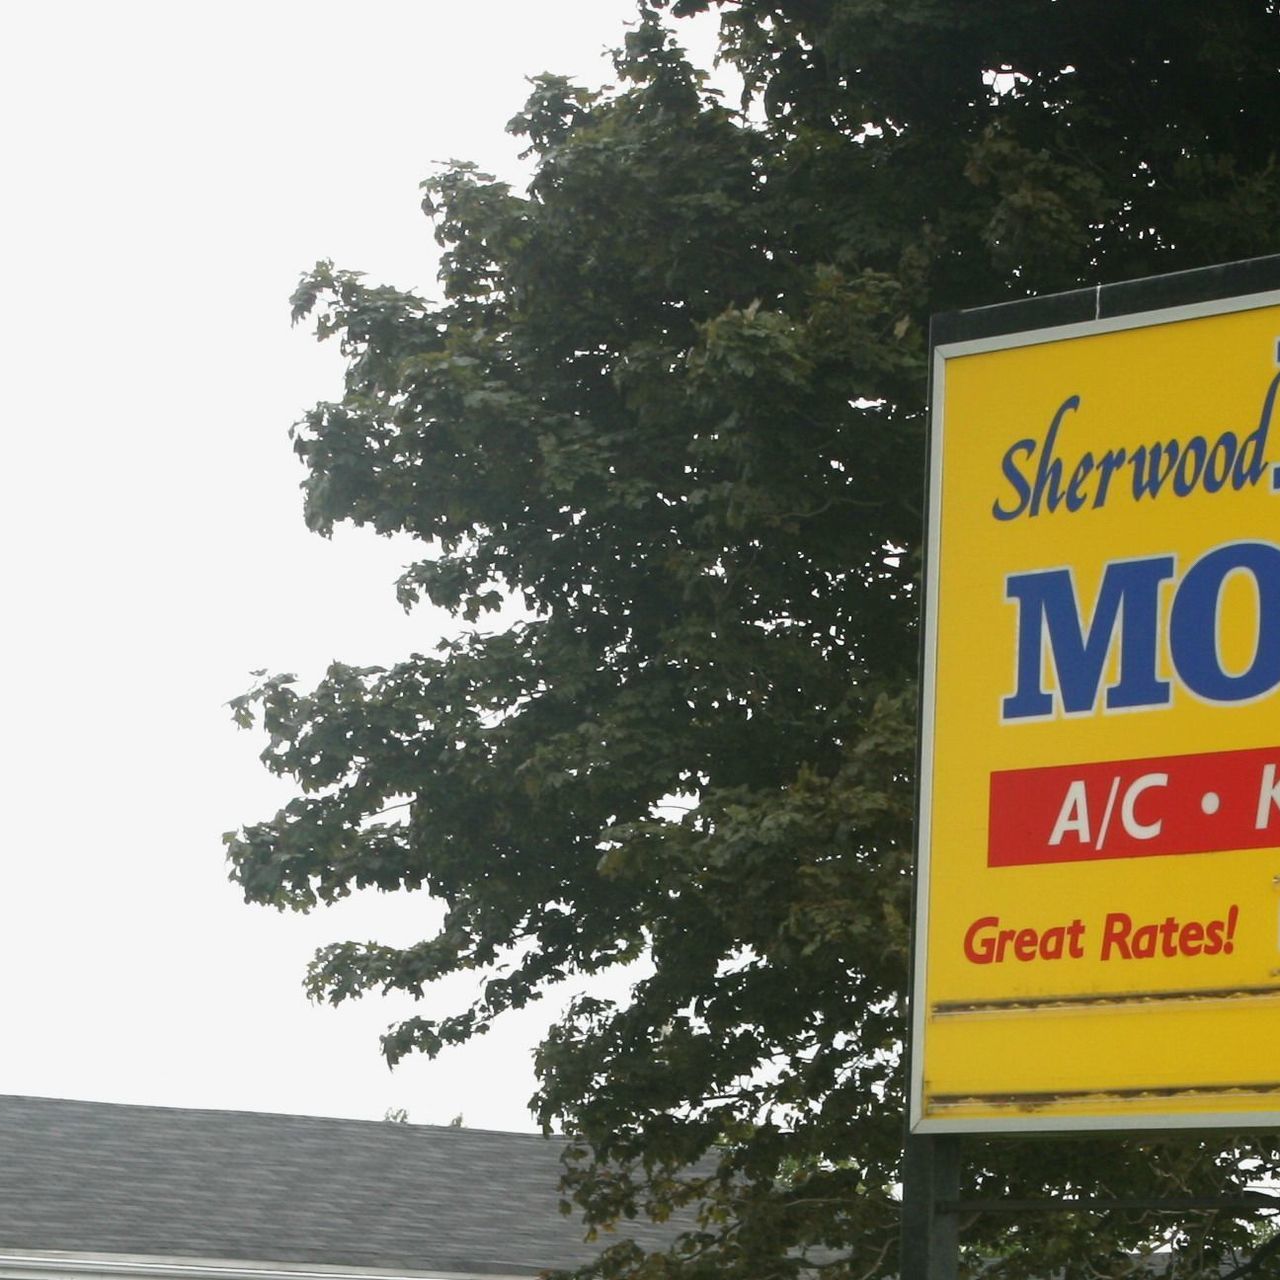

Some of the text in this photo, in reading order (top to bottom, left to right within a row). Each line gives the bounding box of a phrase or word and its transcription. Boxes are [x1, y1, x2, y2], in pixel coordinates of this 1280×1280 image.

[1048, 772, 1169, 851] A/C
[963, 904, 1240, 965] Great Rates!
